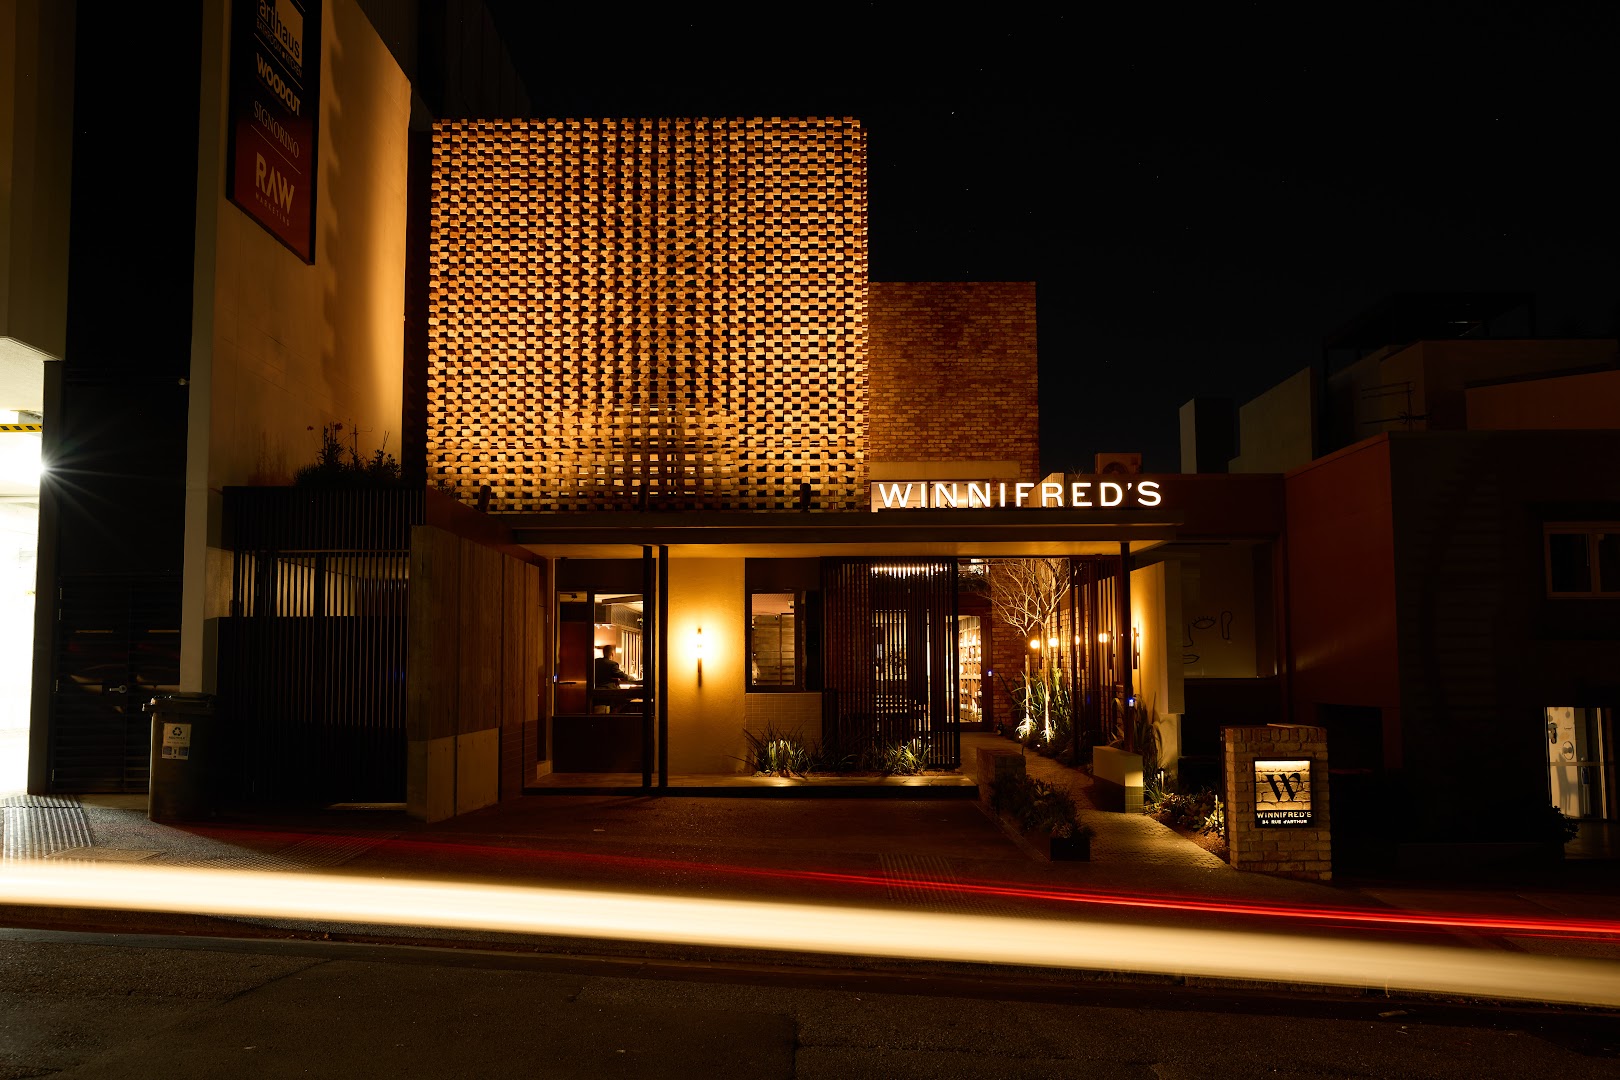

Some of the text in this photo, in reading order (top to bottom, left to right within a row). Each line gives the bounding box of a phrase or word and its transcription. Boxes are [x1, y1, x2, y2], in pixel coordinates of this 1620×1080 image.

[256, 52, 301, 117] WOODCUT
[254, 100, 300, 159] SIGNORINO
[255, 151, 295, 215] RAW
[878, 481, 1162, 508] WINNIFRED'S
[1265, 773, 1305, 802] W
